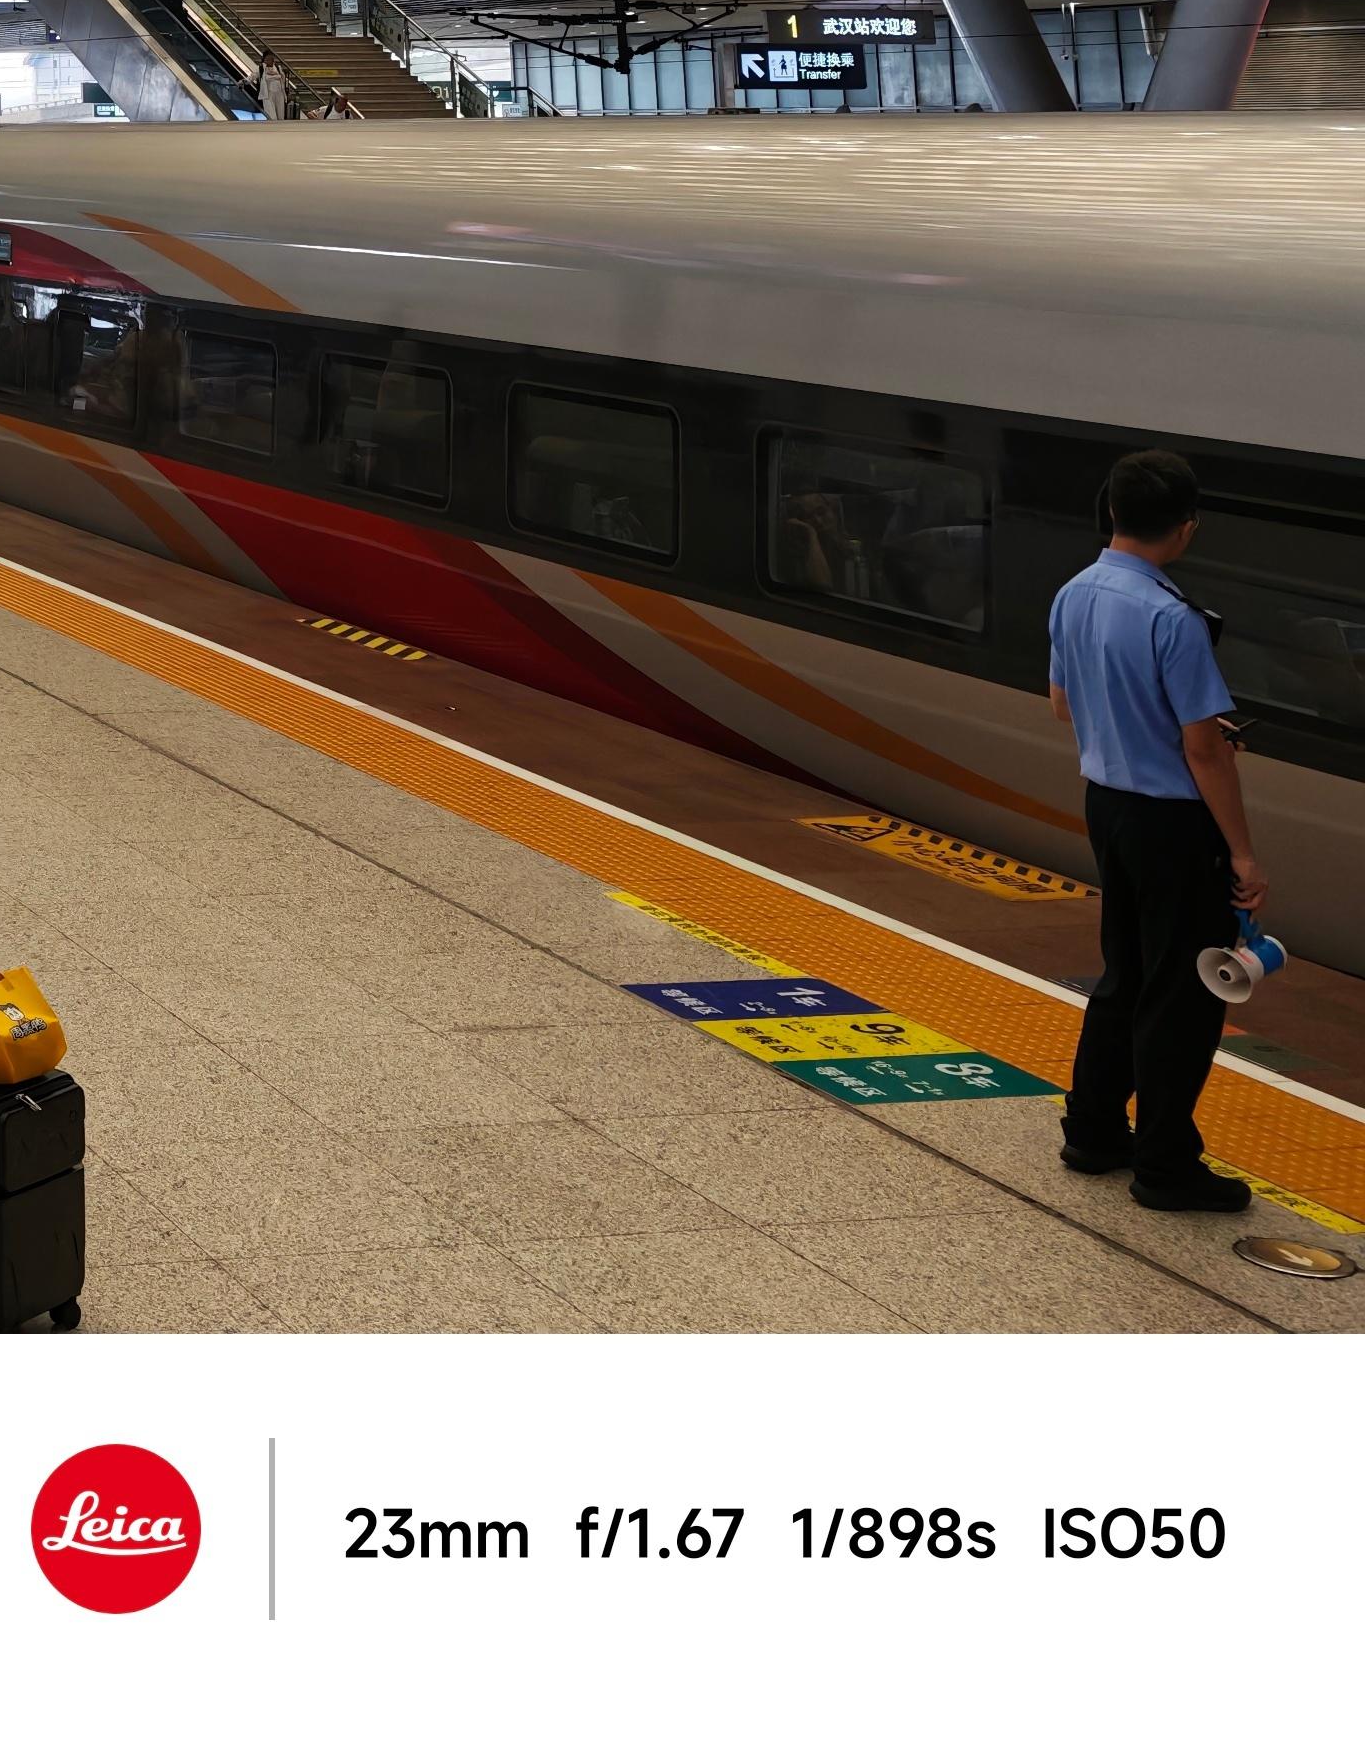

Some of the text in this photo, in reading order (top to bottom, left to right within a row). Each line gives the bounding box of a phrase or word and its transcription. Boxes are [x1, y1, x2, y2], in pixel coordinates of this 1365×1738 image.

[787, 14, 917, 38] 1 武汉站欢迎您
[798, 52, 855, 68] 便捷换乘
[799, 69, 842, 80] Transfer
